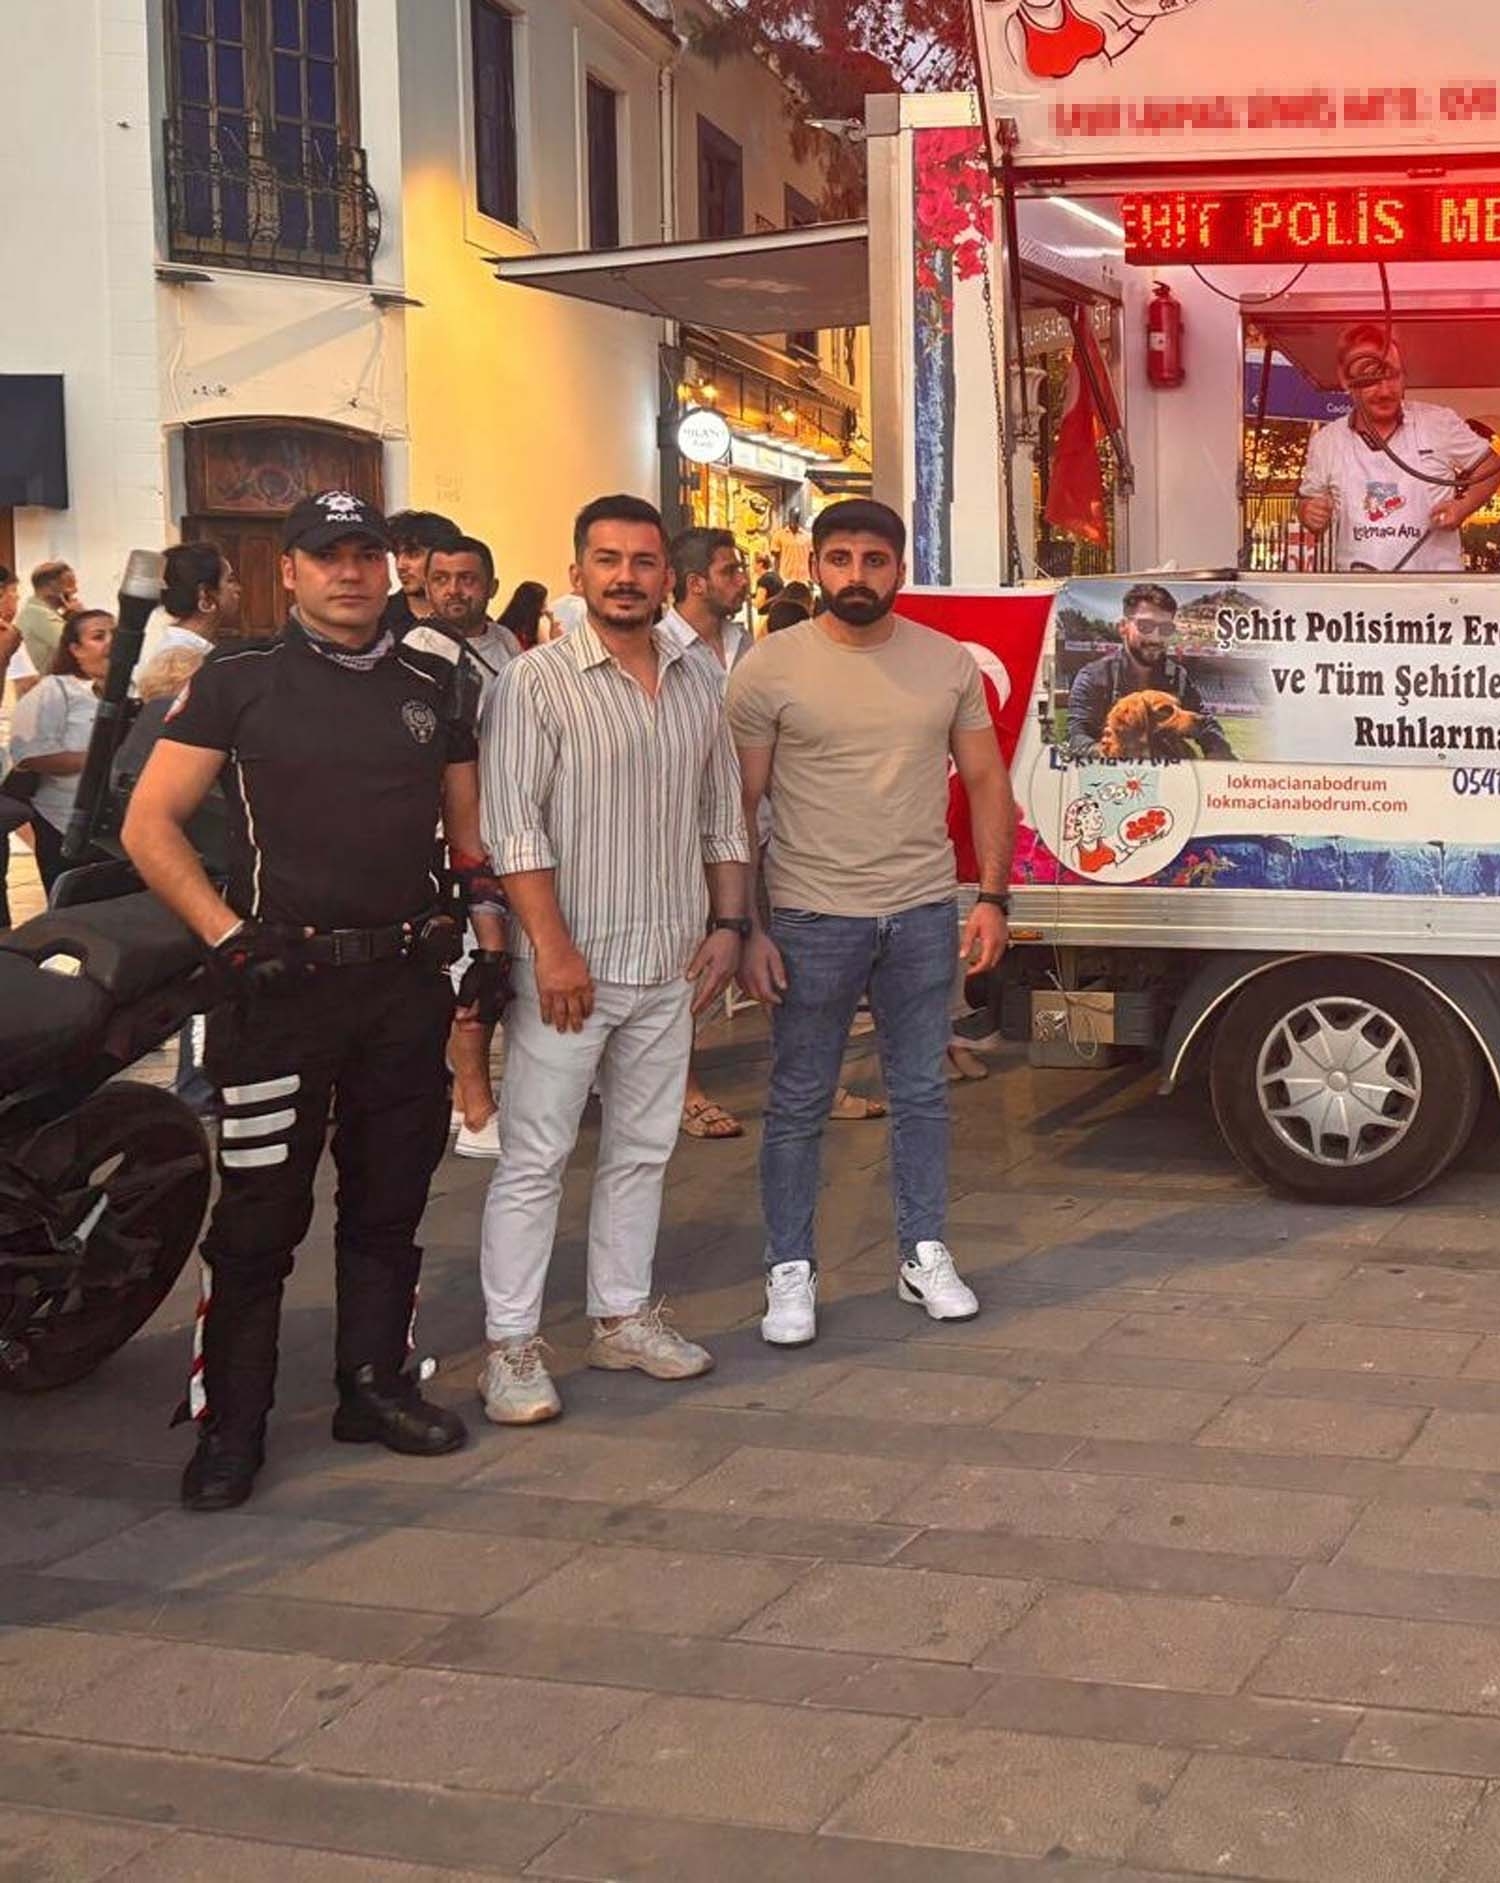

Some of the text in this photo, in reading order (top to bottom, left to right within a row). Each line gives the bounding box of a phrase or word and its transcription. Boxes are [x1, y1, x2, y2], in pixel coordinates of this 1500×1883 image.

[1252, 191, 1404, 247] POLİS
[1217, 609, 1296, 649] Şehit
[1305, 611, 1453, 645] Polisimiz
[1272, 667, 1306, 694] ve
[1315, 661, 1385, 696] Tüm
[1226, 774, 1388, 792] lokmacianabodrum
[1206, 794, 1408, 813] lokmacianabodrum.com
